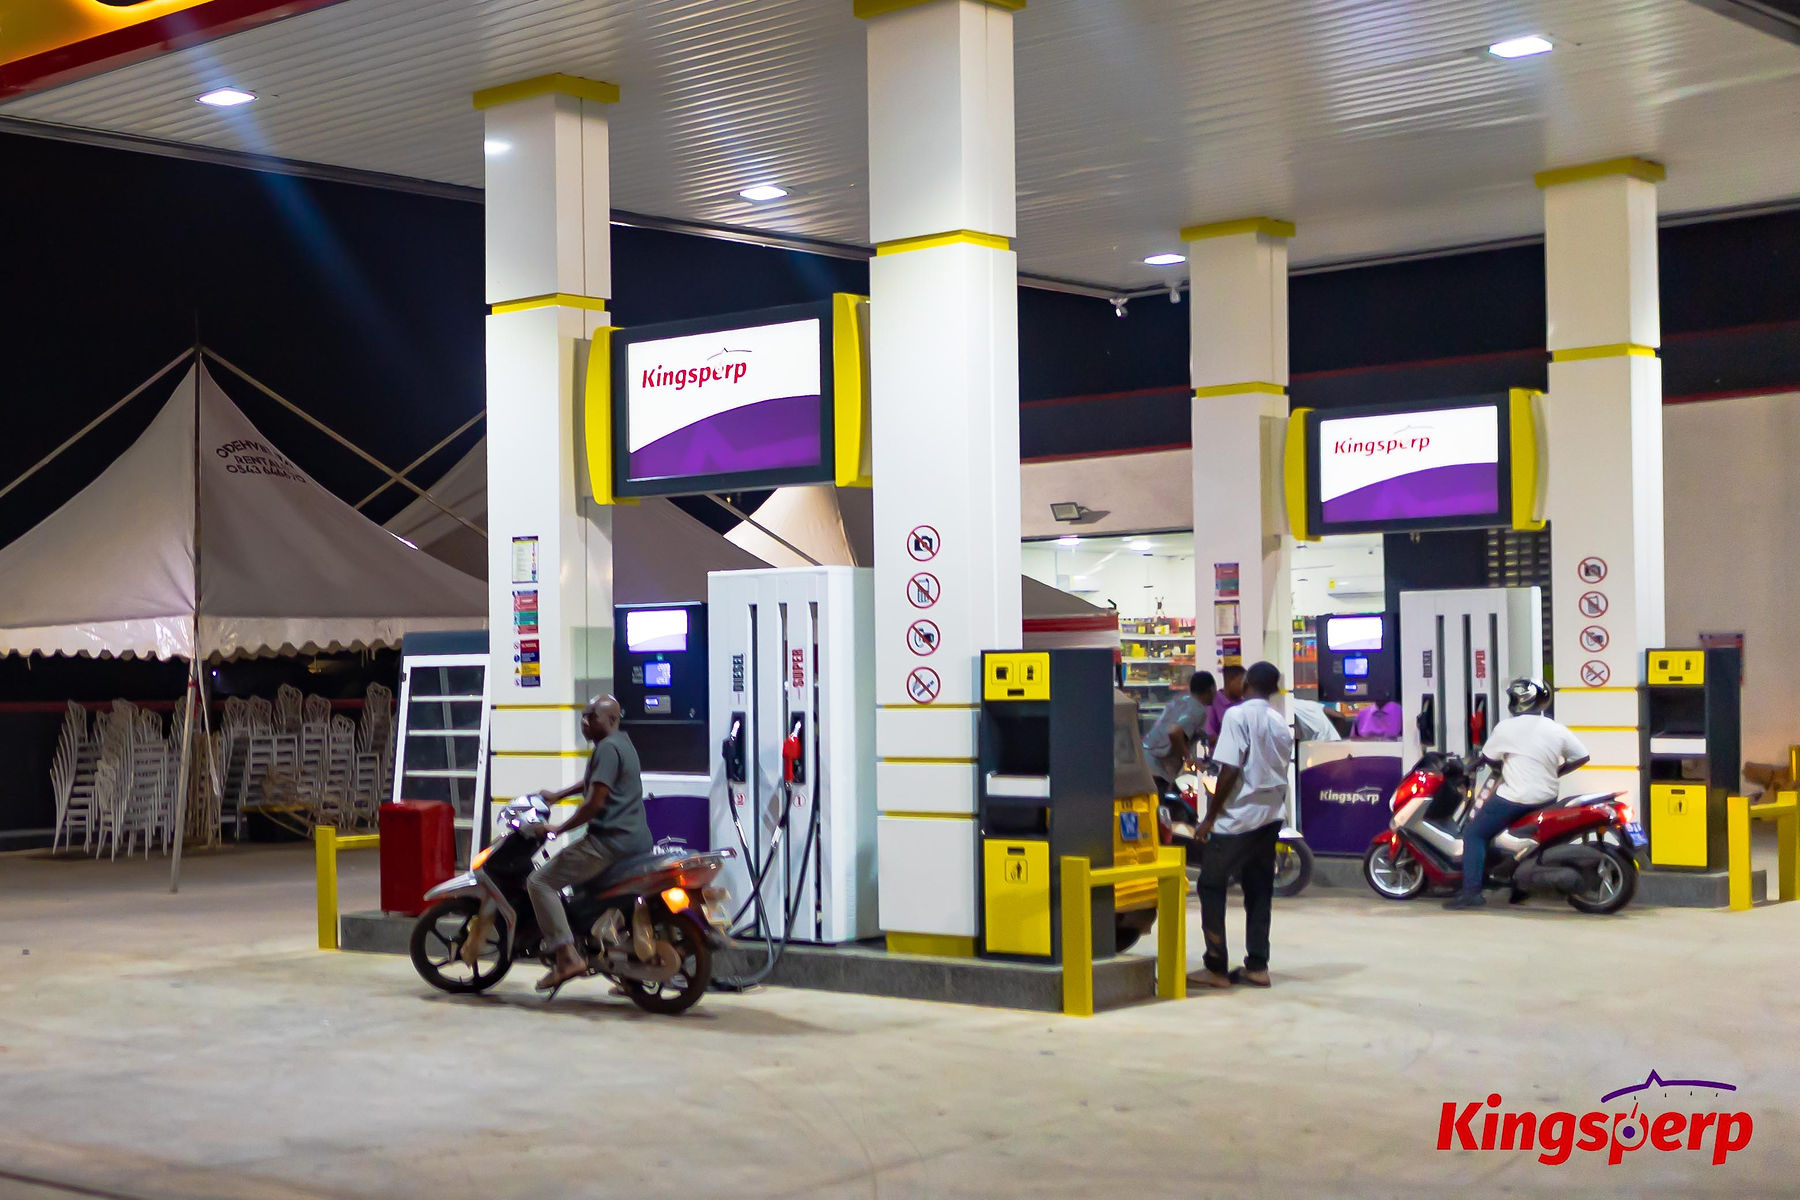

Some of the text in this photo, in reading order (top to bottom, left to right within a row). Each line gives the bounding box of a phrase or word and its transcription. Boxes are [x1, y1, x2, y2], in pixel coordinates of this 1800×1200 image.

[642, 362, 746, 390] Kingsperp
[1335, 437, 1430, 456] Kingsperp
[792, 648, 804, 688] SUPER
[1319, 789, 1380, 805] Kingsperp
